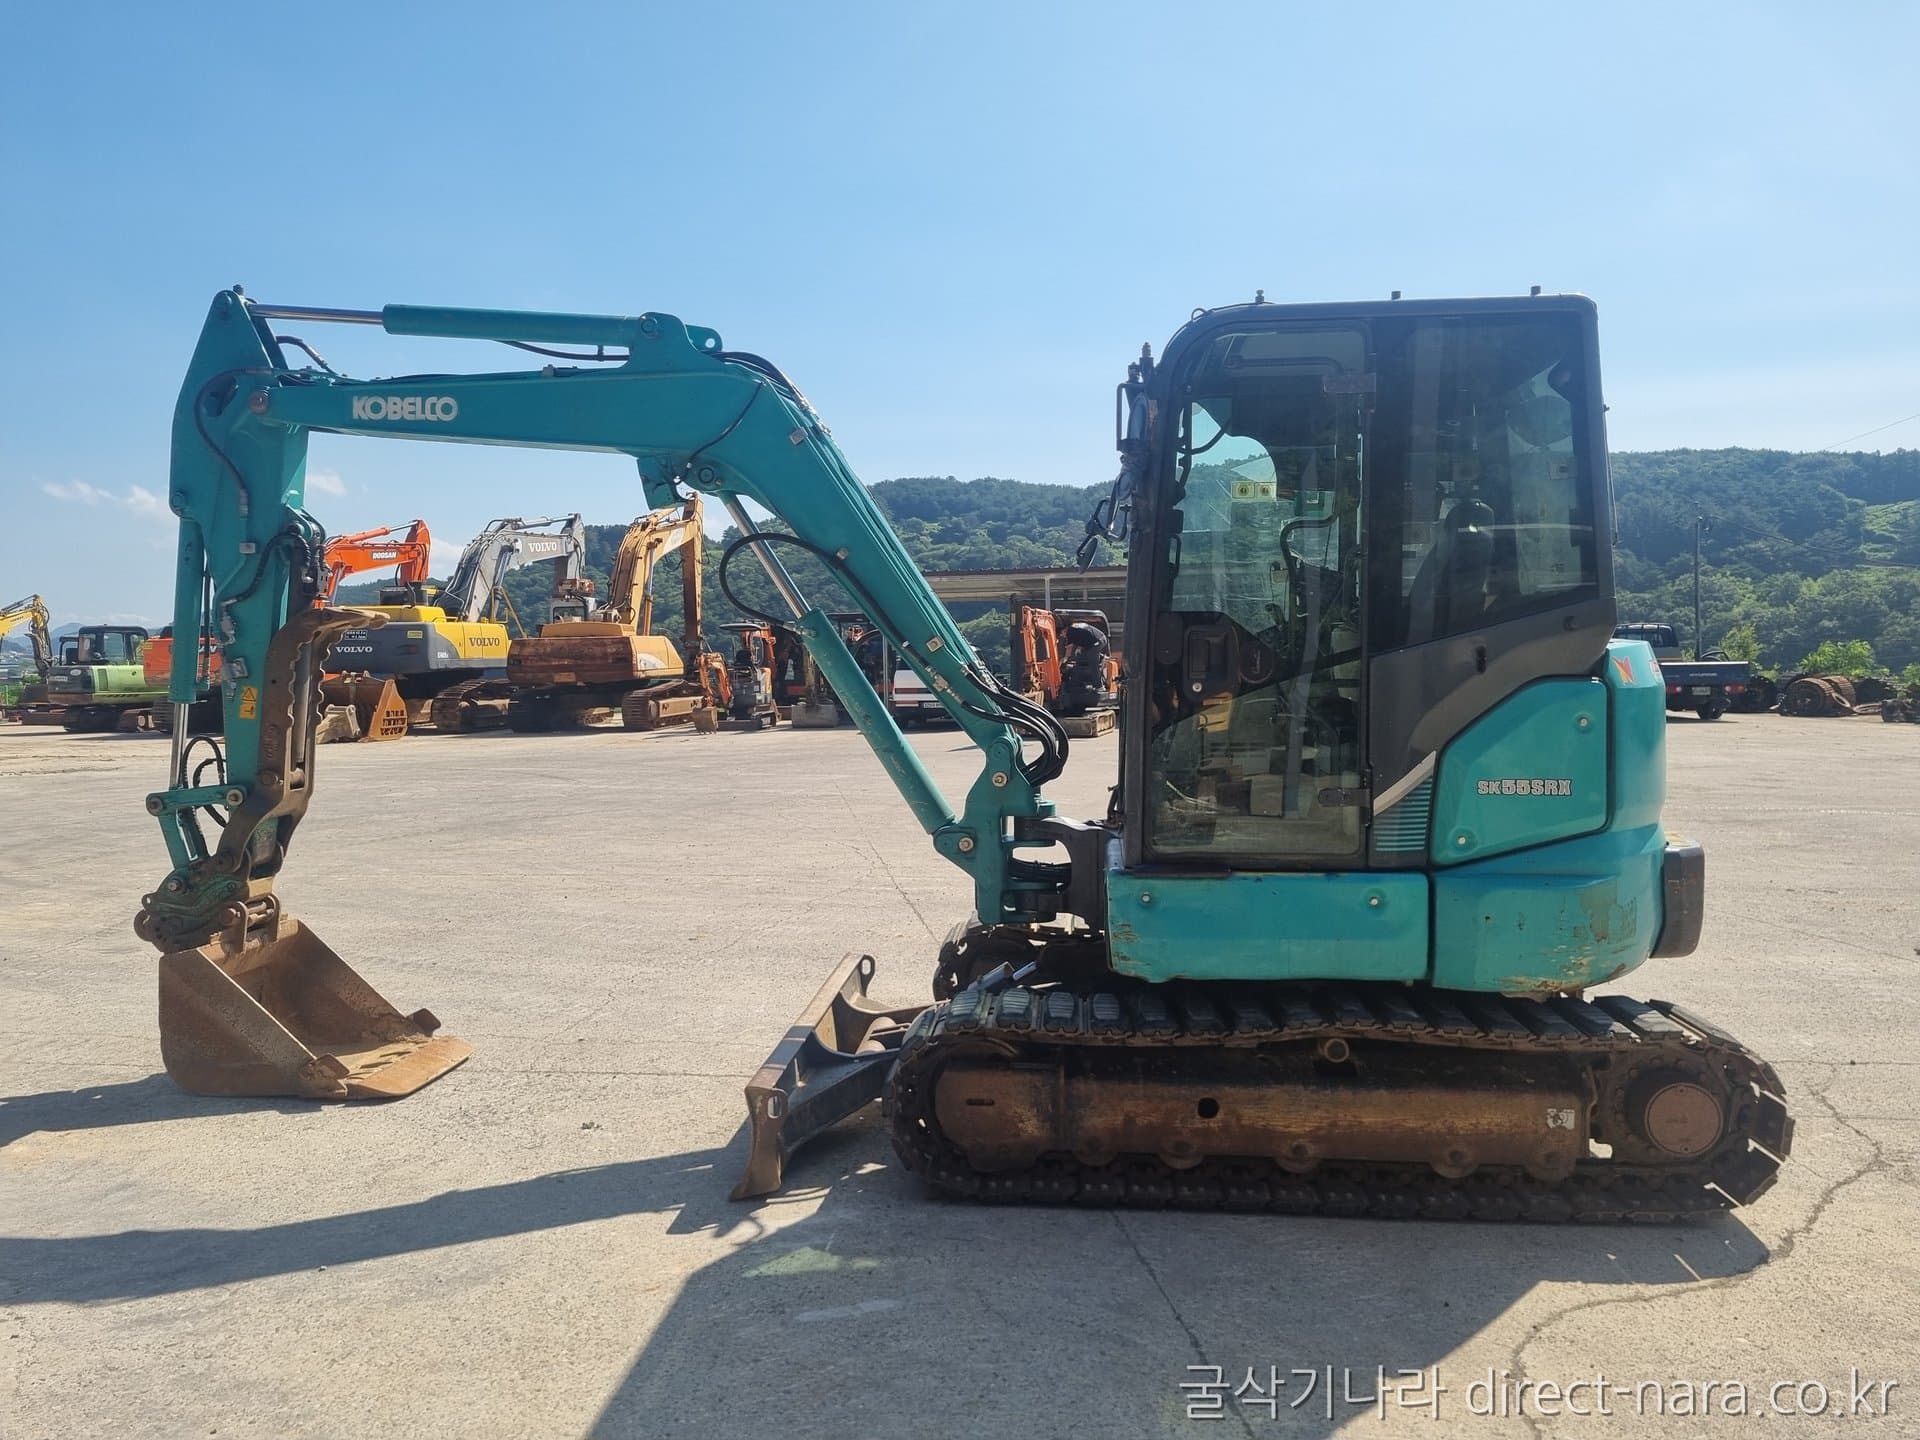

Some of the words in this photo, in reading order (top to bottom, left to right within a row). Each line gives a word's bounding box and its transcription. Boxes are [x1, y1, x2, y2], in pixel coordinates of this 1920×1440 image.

[352, 396, 458, 421] KOBELCO
[528, 542, 557, 553] VOLVO
[469, 637, 500, 647] VOLVO
[1477, 779, 1571, 796] SK55SRX
